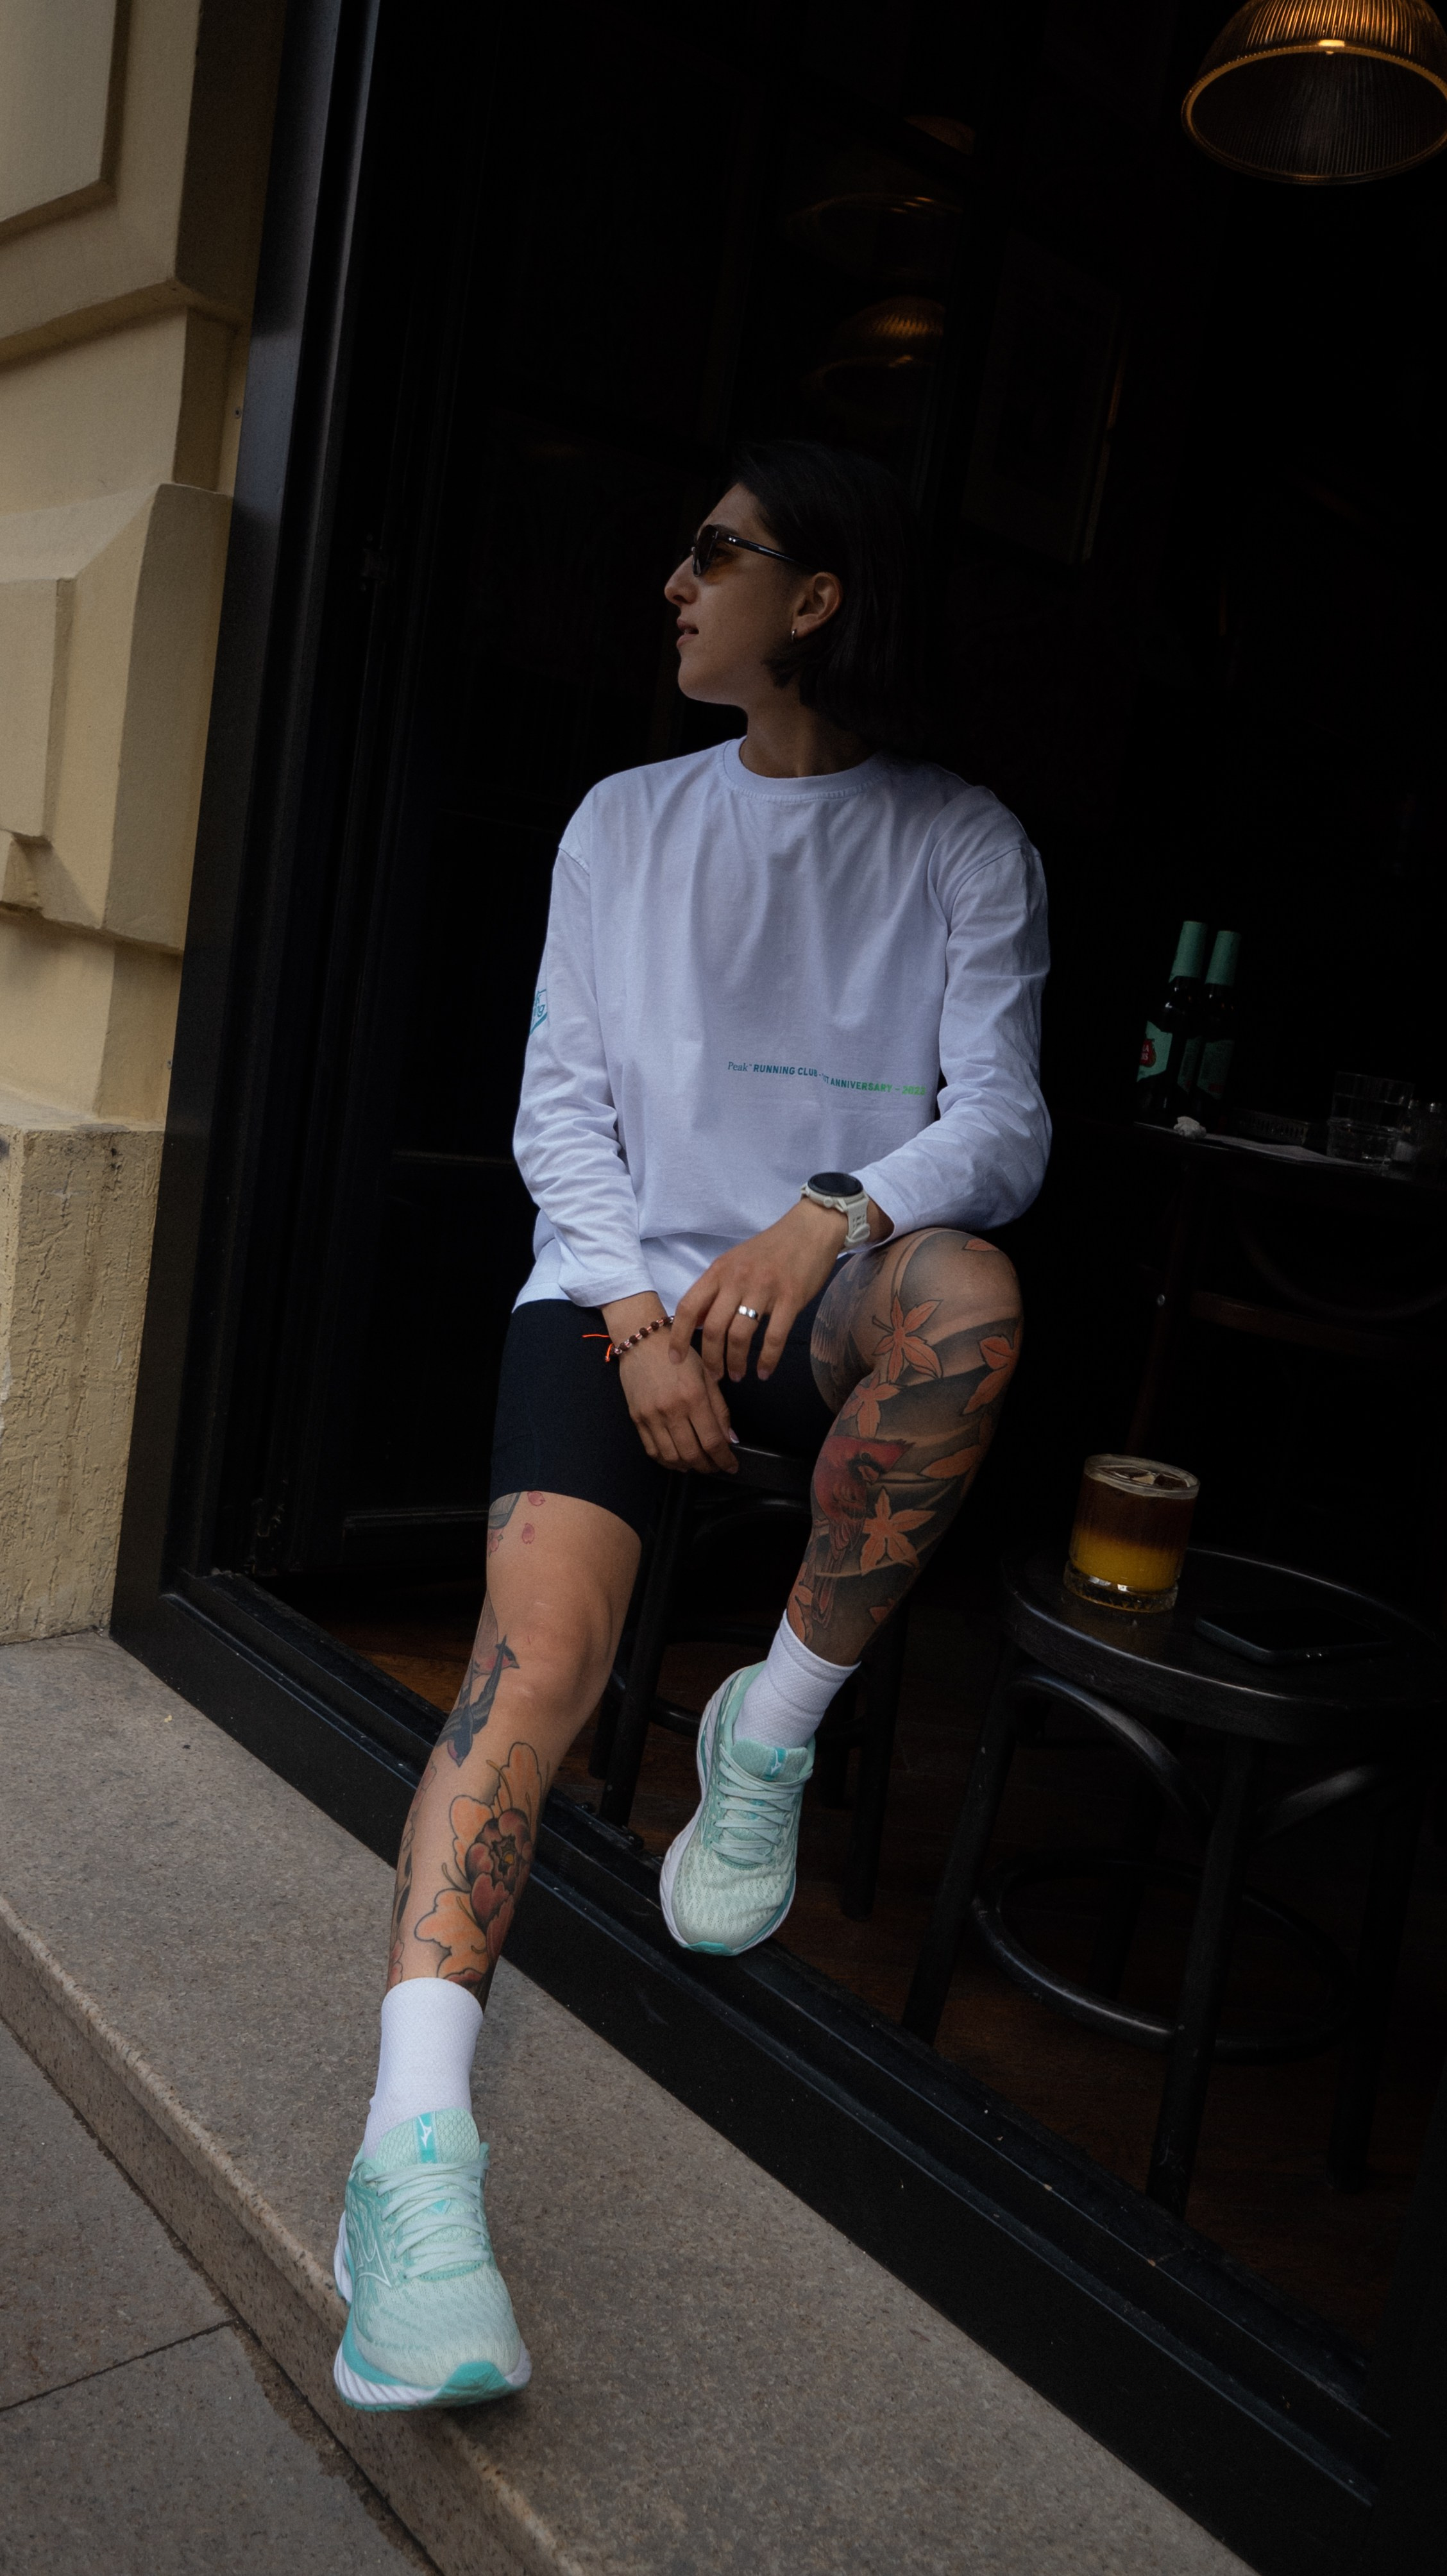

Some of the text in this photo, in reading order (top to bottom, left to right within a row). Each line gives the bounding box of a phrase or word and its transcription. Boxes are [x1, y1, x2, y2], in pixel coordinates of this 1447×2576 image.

[754, 1064, 795, 1075] RUNNING
[797, 1067, 818, 1077] CLUB
[831, 1078, 893, 1092] ANNIVERSARY
